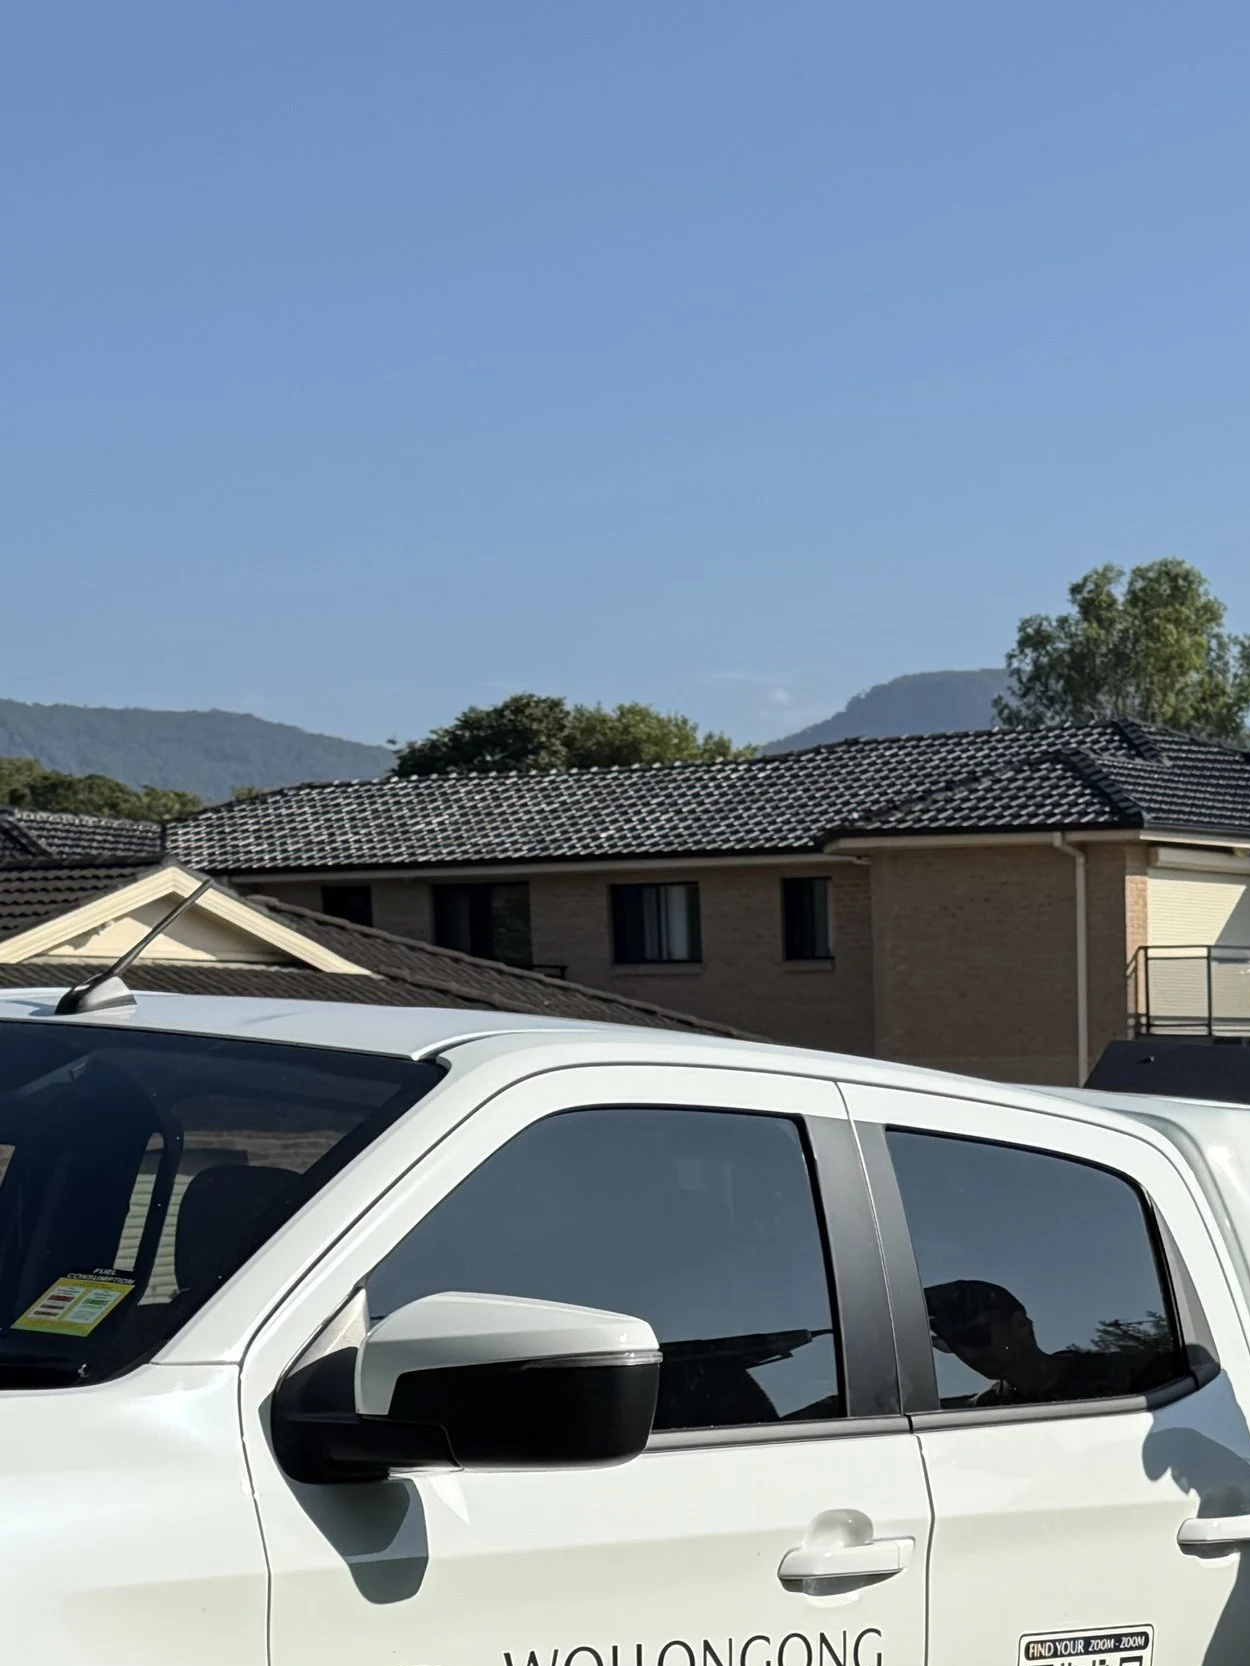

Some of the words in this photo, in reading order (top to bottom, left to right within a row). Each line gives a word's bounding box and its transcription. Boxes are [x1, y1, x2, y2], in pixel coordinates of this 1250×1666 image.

[93, 1268, 117, 1276] FUEL
[1029, 1642, 1054, 1658] FIND
[1056, 1640, 1085, 1656] YOUR
